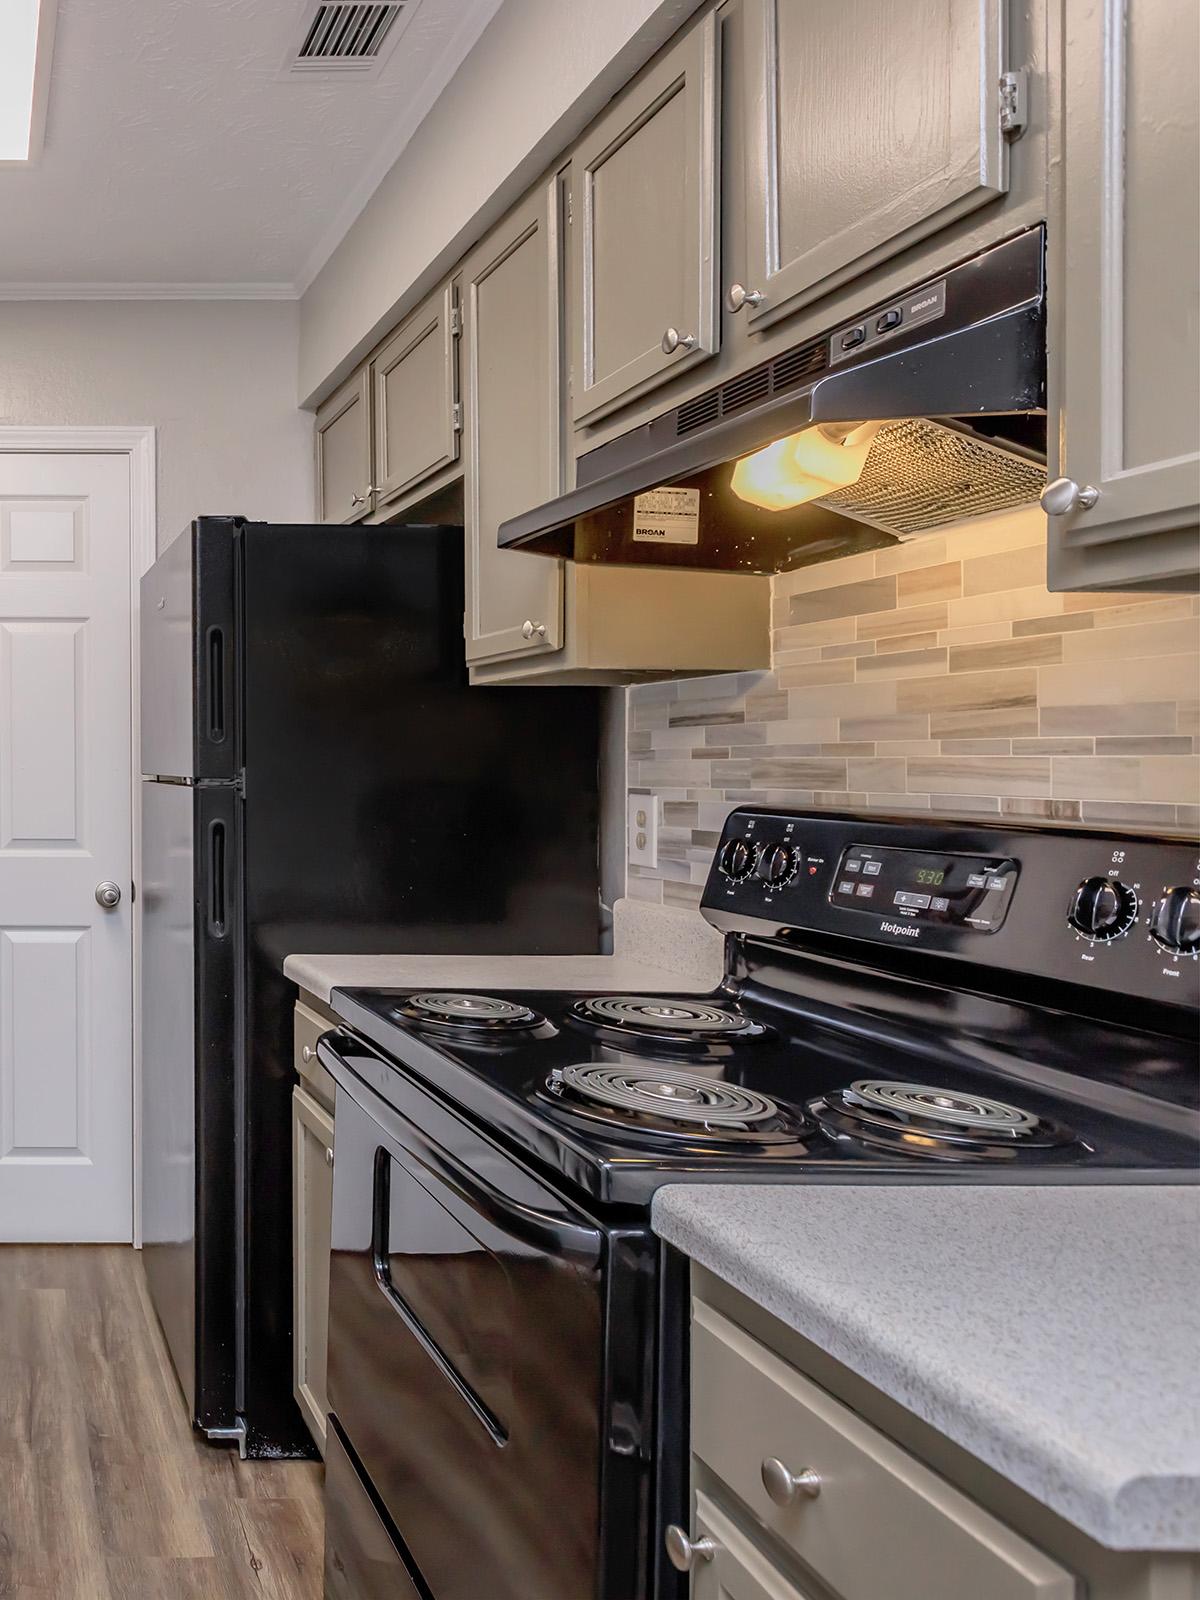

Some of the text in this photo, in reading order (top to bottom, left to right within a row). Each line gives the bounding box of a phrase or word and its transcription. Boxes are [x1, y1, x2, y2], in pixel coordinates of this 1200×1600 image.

[911, 296, 938, 313] BROAN
[636, 528, 666, 536] BROAN
[880, 921, 920, 937] Hotpoint
[1162, 969, 1180, 977] Front
